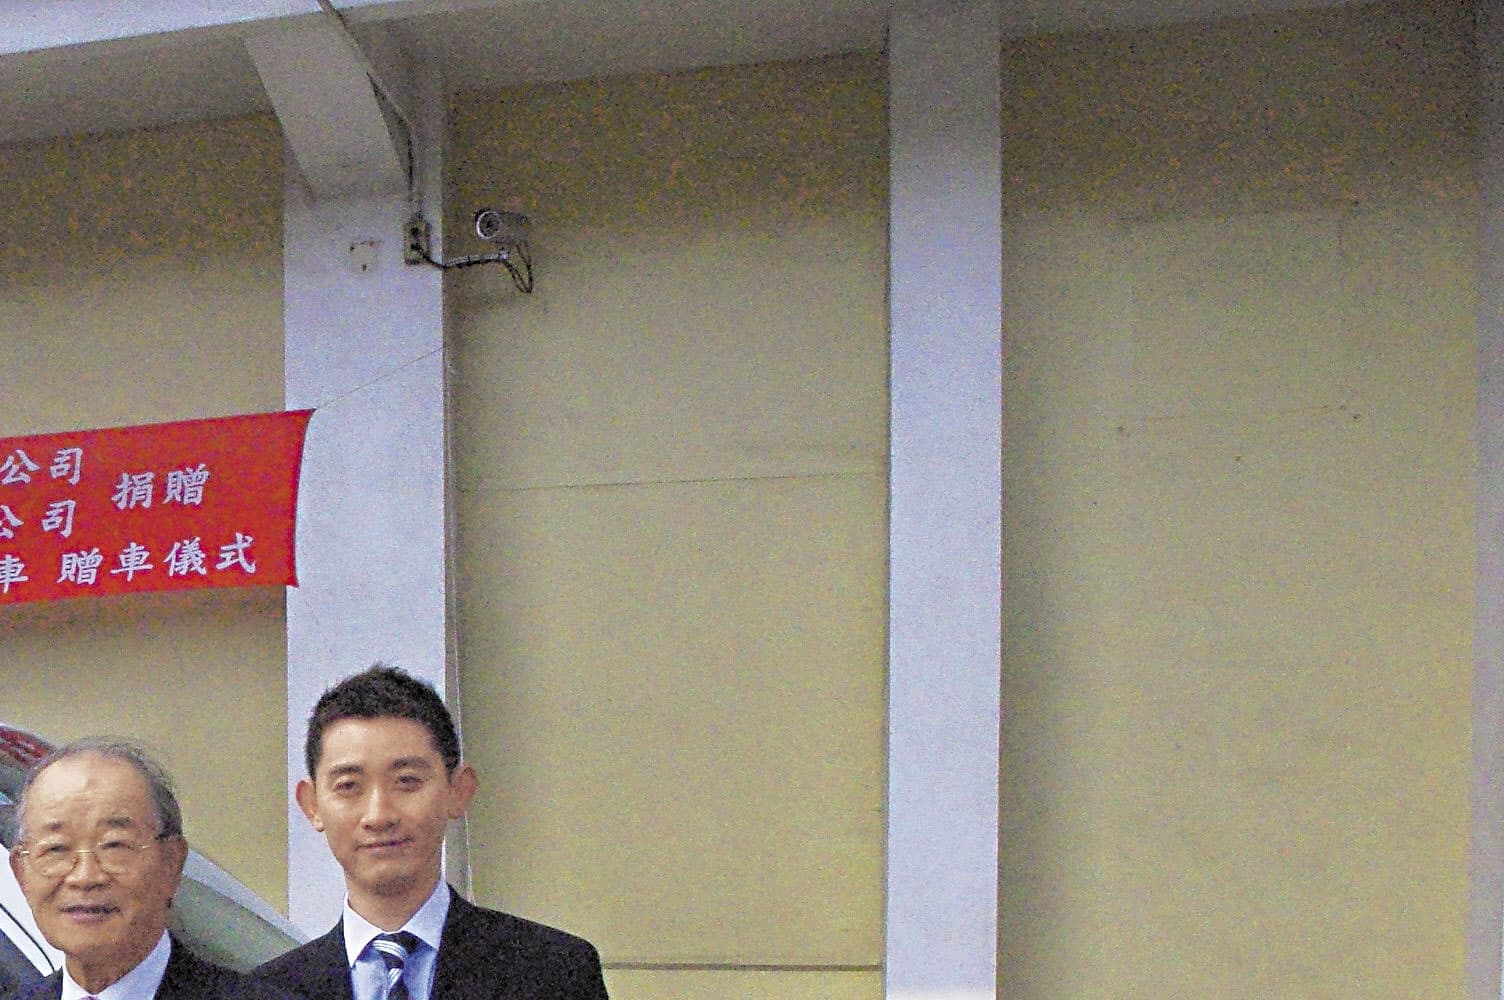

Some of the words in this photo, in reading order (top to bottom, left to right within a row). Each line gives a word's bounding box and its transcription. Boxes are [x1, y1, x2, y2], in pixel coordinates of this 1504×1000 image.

[110, 462, 211, 511] 捐贈
[56, 531, 257, 586] 贈車儀式
